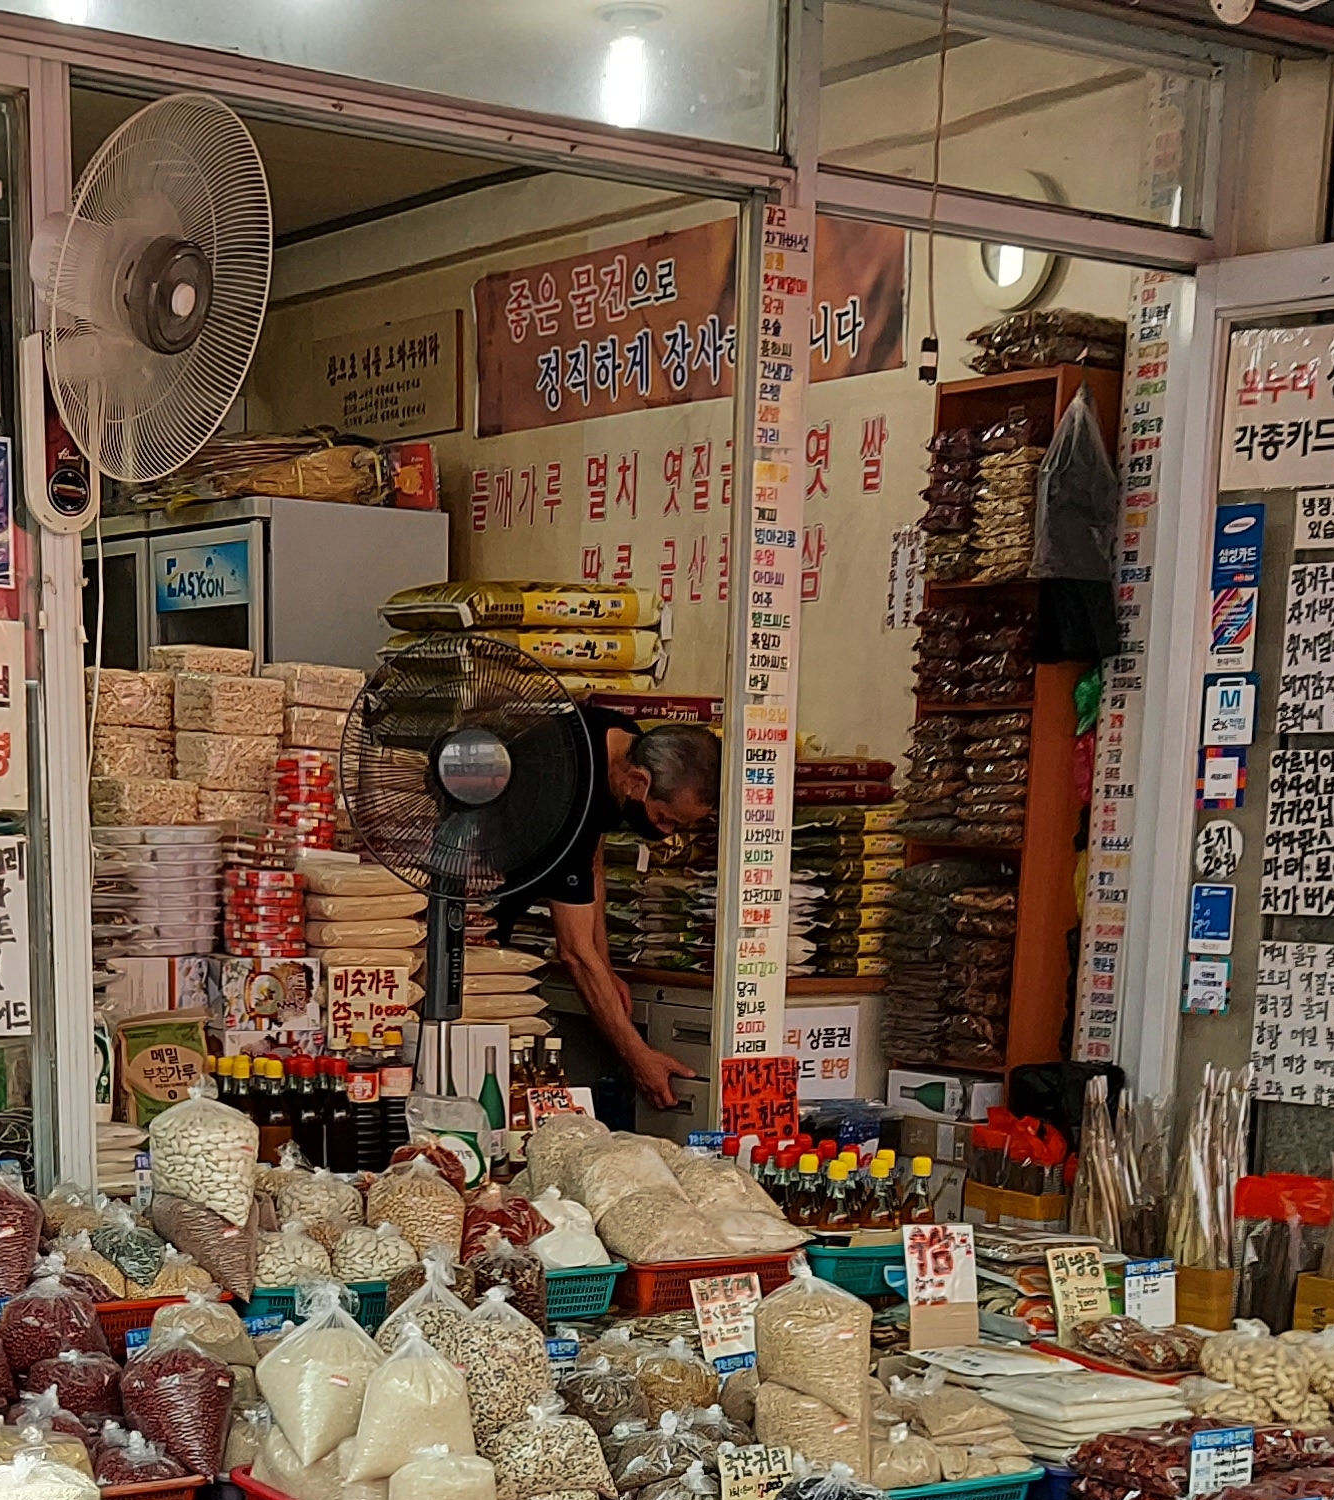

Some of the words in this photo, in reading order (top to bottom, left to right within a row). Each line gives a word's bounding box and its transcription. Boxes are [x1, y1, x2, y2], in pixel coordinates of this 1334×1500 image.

[505, 270, 562, 343] 좋은
[568, 254, 678, 330] 물건으로
[536, 331, 653, 411] 정직하게
[1237, 364, 1318, 405] 온누리
[471, 463, 563, 532] 들깨가루
[585, 452, 639, 521] 멸치
[805, 422, 832, 501] 엿
[860, 414, 888, 495] 쌀
[754, 527, 797, 547] 병아리콩
[1220, 690, 1240, 708] M
[1266, 829, 1334, 855] 아마란스
[334, 969, 399, 1000] 미숫가루
[737, 981, 758, 998] 당귀
[735, 1020, 767, 1034] 오미자
[806, 1026, 851, 1050] 상품권
[150, 1047, 179, 1064] 메밀
[734, 1039, 767, 1054] 서리태
[143, 1064, 197, 1083] 부침가루
[820, 1057, 850, 1080] 환영
